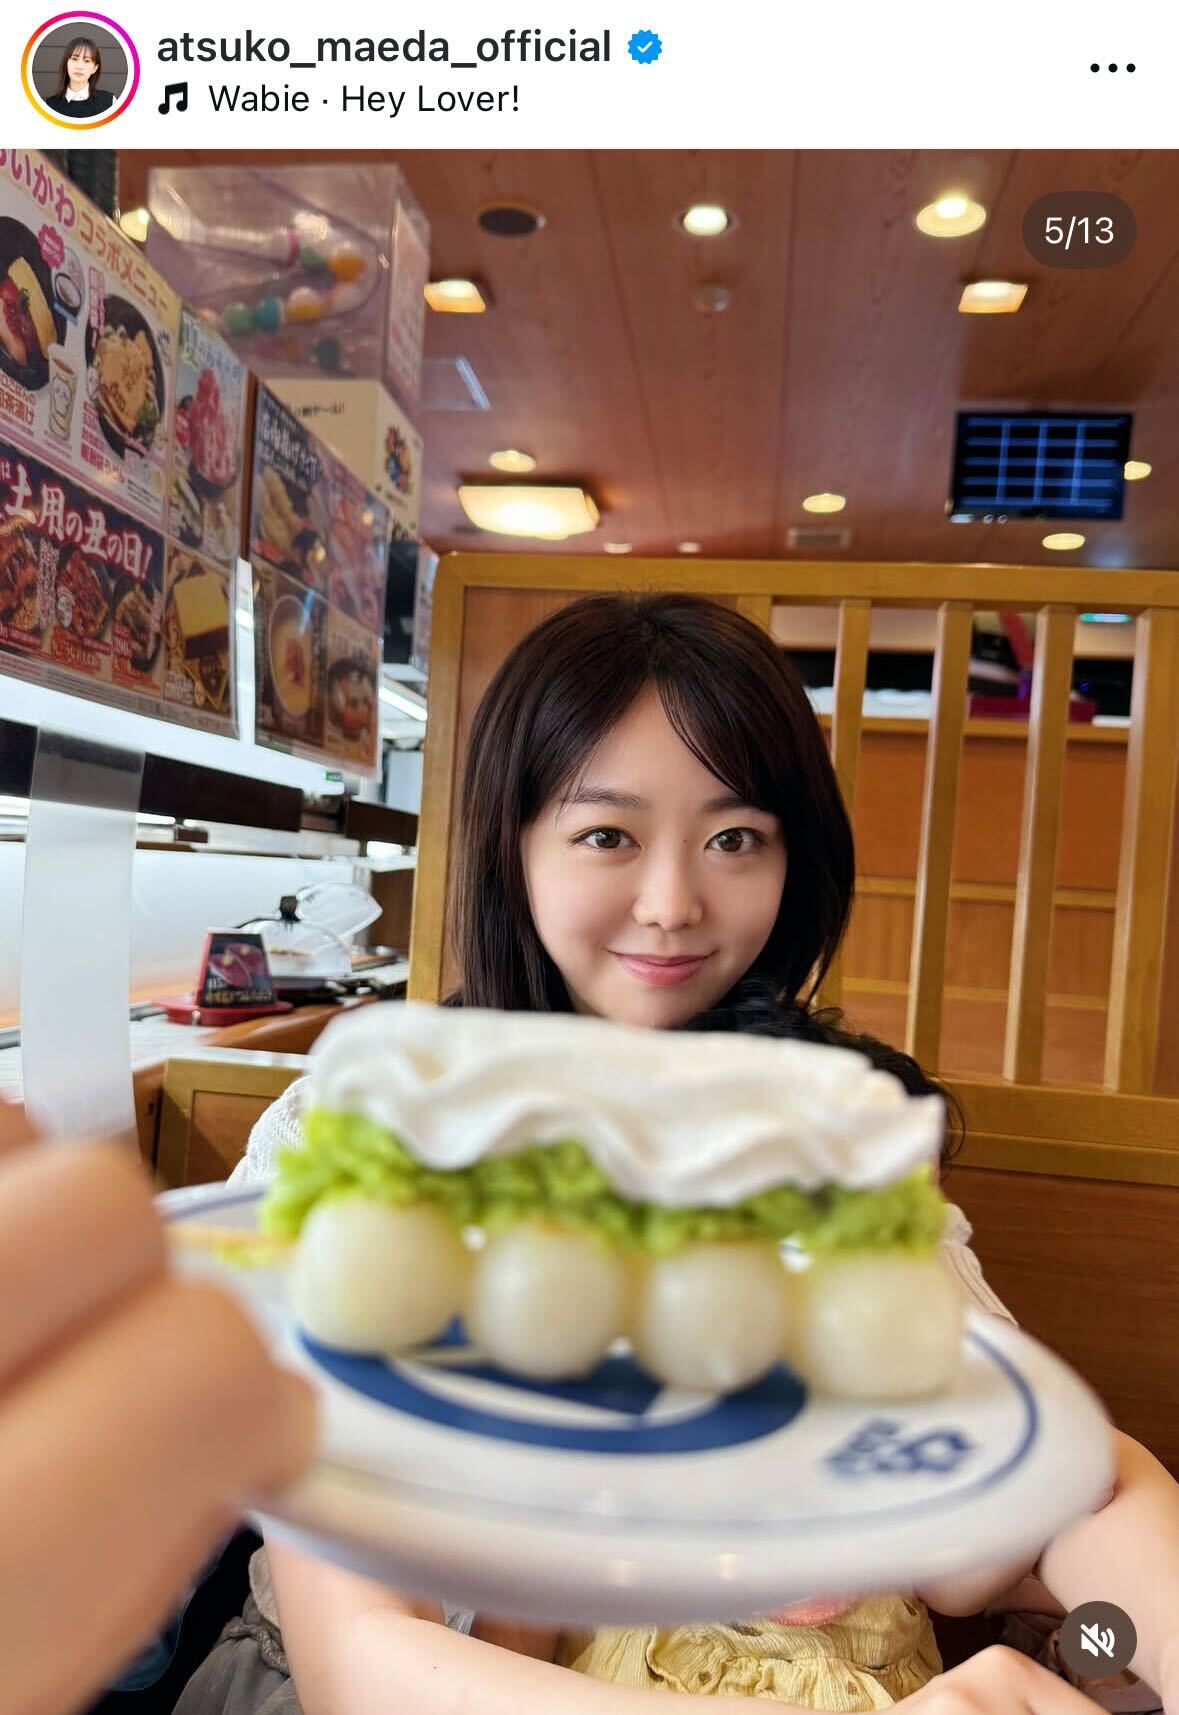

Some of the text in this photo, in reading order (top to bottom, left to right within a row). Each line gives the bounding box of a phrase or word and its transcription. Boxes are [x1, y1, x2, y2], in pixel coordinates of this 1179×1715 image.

[0, 149, 76, 228] いかわ
[4, 463, 153, 580] 土用の丑の日!
